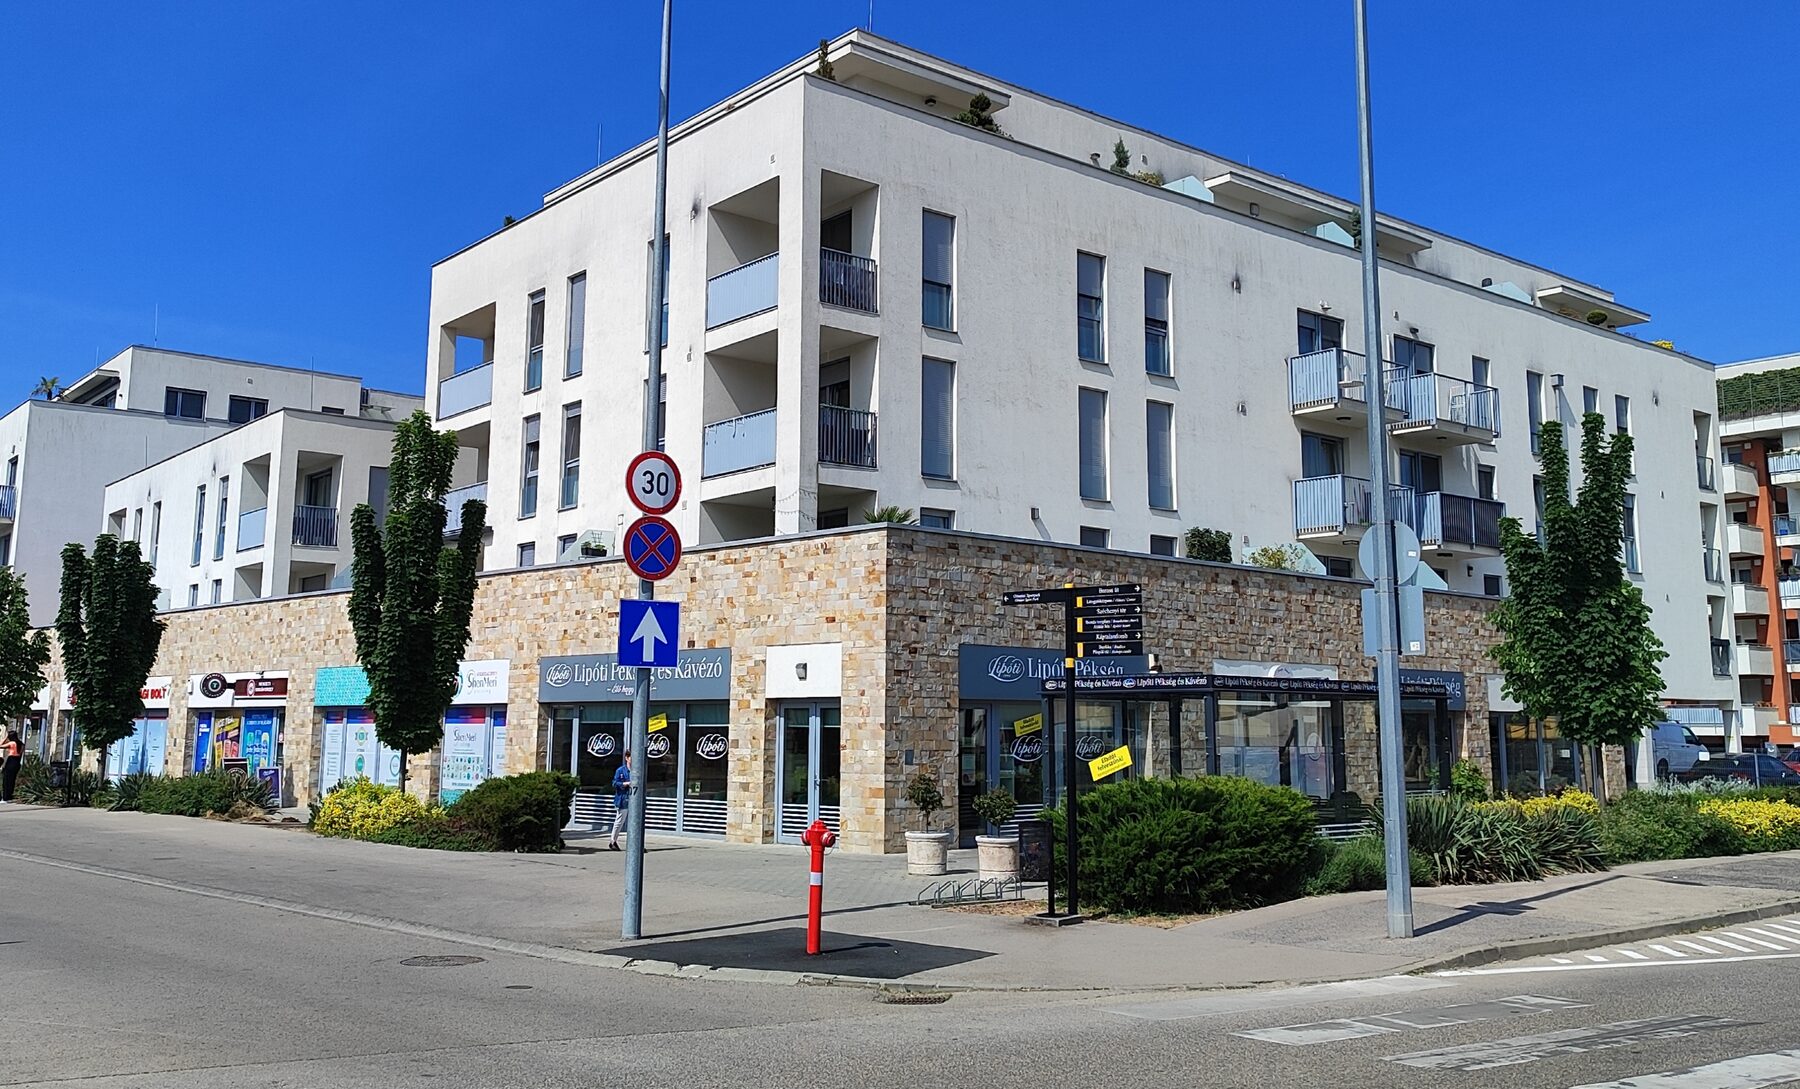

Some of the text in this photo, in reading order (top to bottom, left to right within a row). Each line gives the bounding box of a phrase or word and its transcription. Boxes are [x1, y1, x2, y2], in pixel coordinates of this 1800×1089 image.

[641, 470, 669, 496] 30
[547, 664, 571, 686] Lipóti
[574, 662, 608, 685] Lipóti
[674, 656, 723, 679] Kávézó
[988, 656, 1024, 682] Lipóti
[1027, 658, 1065, 680] Lipót
[150, 688, 167, 700] BOLT
[1074, 679, 1094, 689] Pékség
[1101, 678, 1122, 688] Kávézó
[1136, 678, 1154, 689] Lipóti
[1154, 678, 1177, 689] Pékség
[1185, 676, 1208, 686] Kávézó
[588, 734, 614, 757] Lipóti
[696, 734, 728, 759] Lipóti
[1011, 736, 1043, 760] Lipóti
